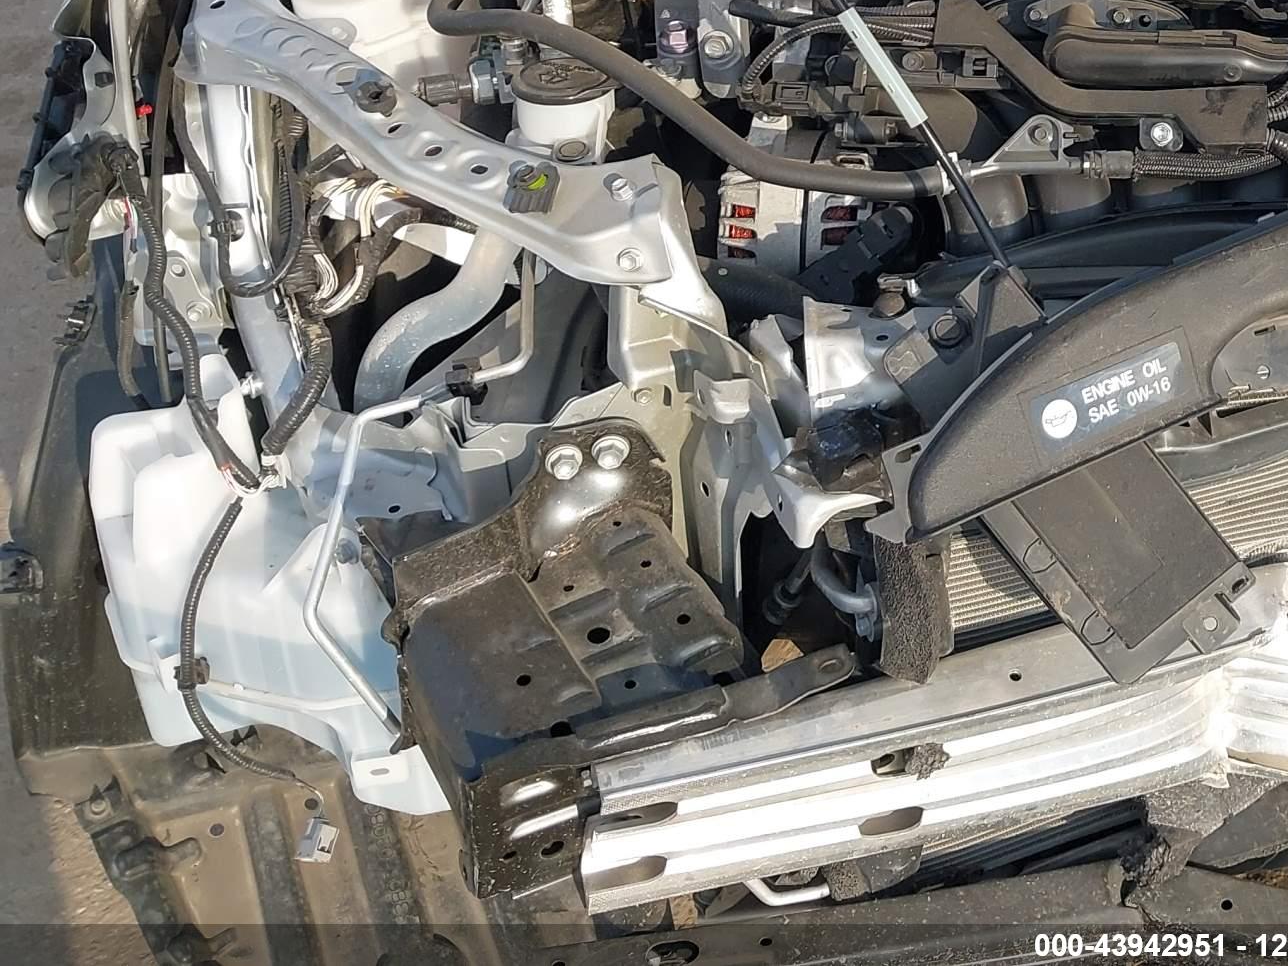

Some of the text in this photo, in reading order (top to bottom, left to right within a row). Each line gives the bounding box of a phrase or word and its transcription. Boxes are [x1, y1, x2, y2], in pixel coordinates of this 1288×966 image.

[1081, 359, 1167, 404] ENGINE OIL
[1089, 377, 1171, 423] SAE 0W-16
